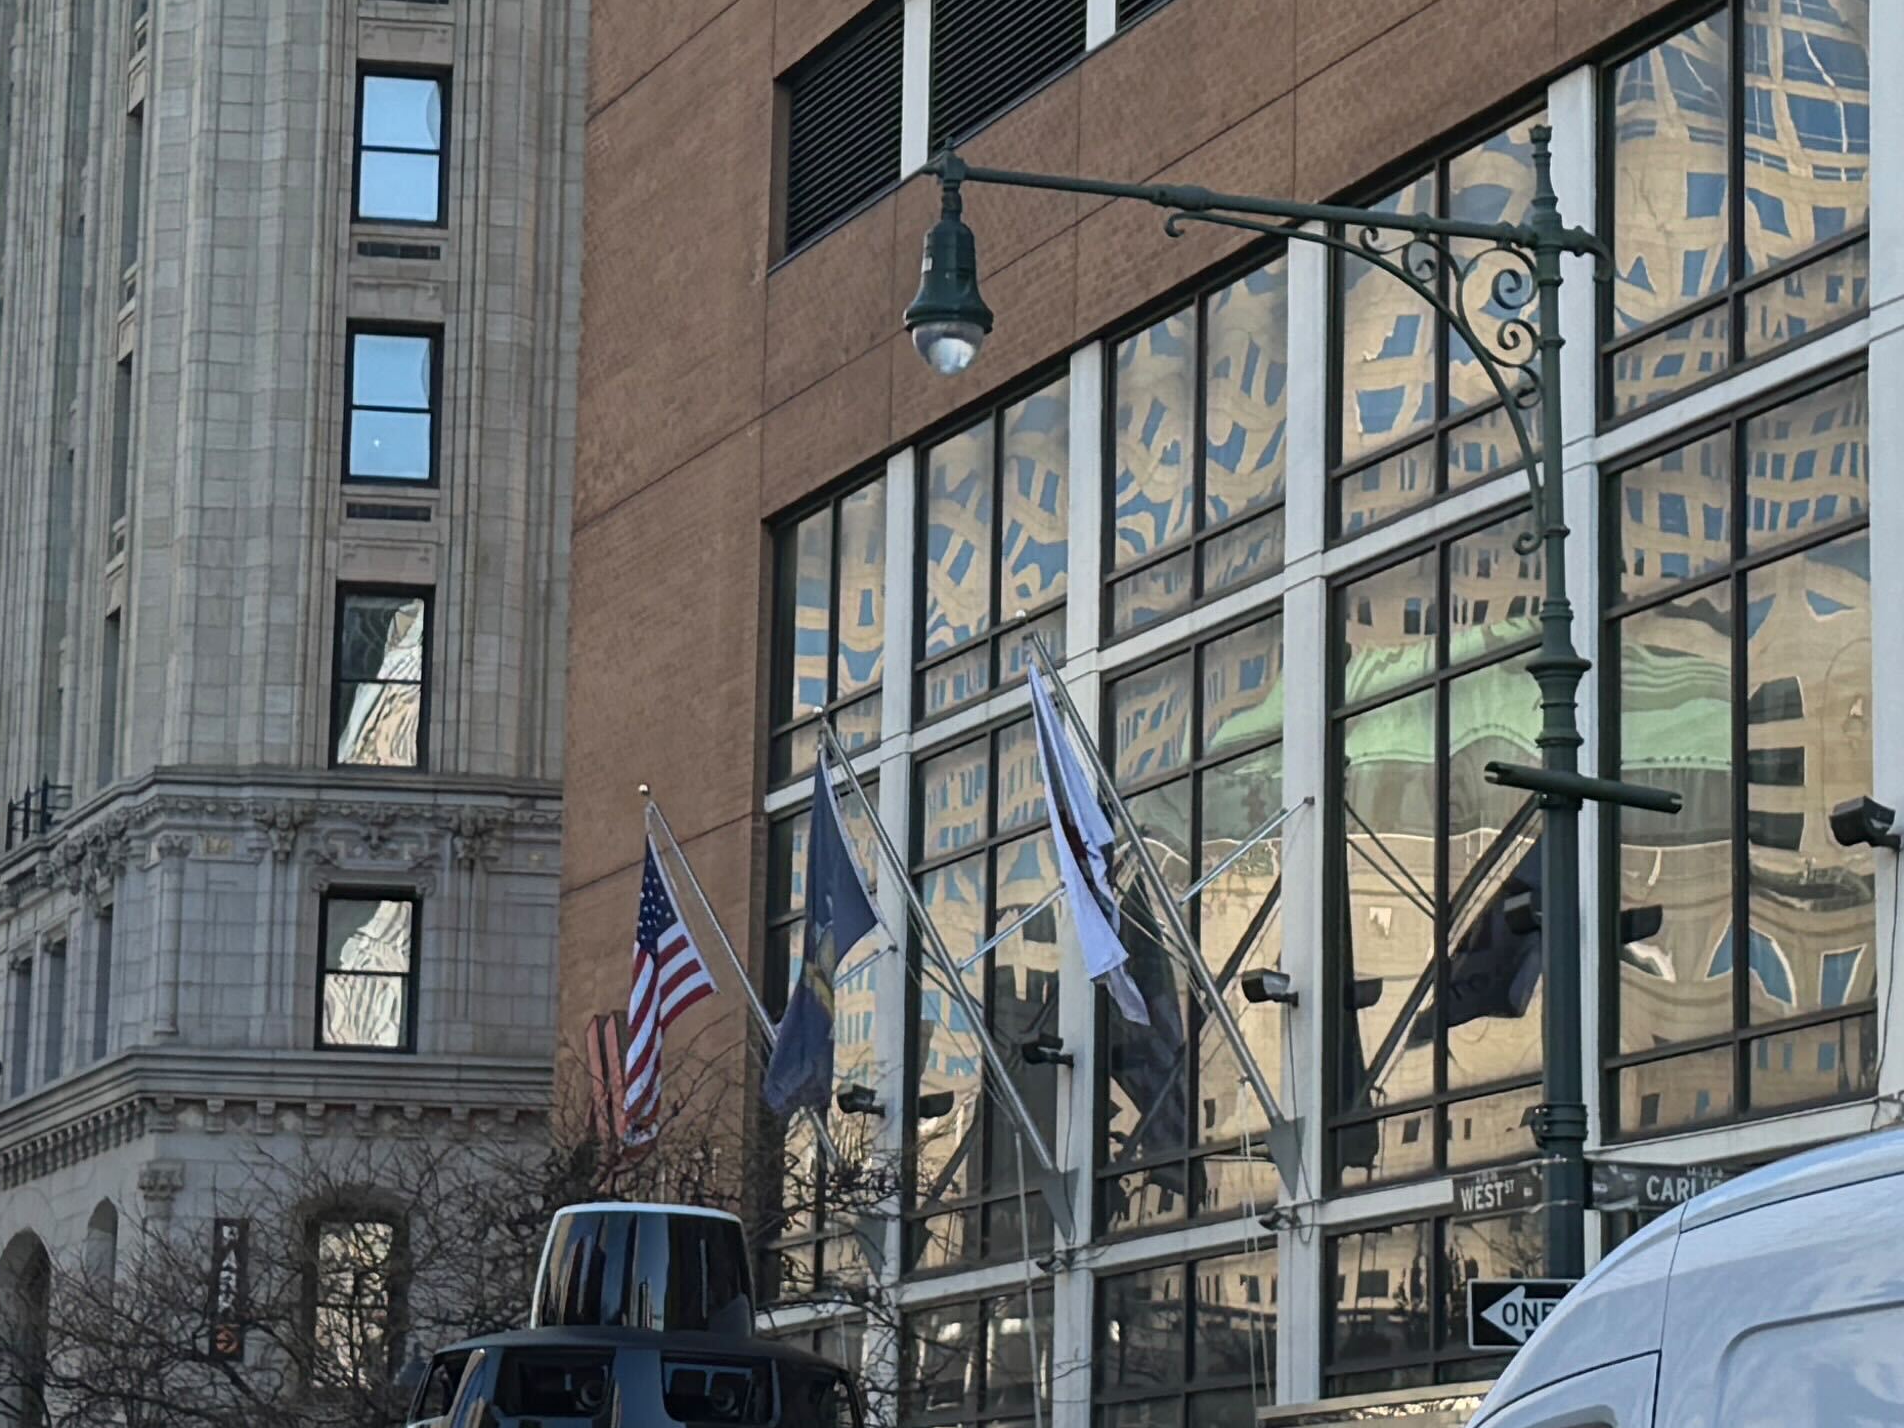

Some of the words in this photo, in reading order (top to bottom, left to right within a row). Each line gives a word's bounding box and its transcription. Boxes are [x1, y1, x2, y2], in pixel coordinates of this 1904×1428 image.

[1460, 1181, 1504, 1211] WEST
[1504, 1179, 1515, 1194] ST
[1646, 1176, 1722, 1202] CARLI
